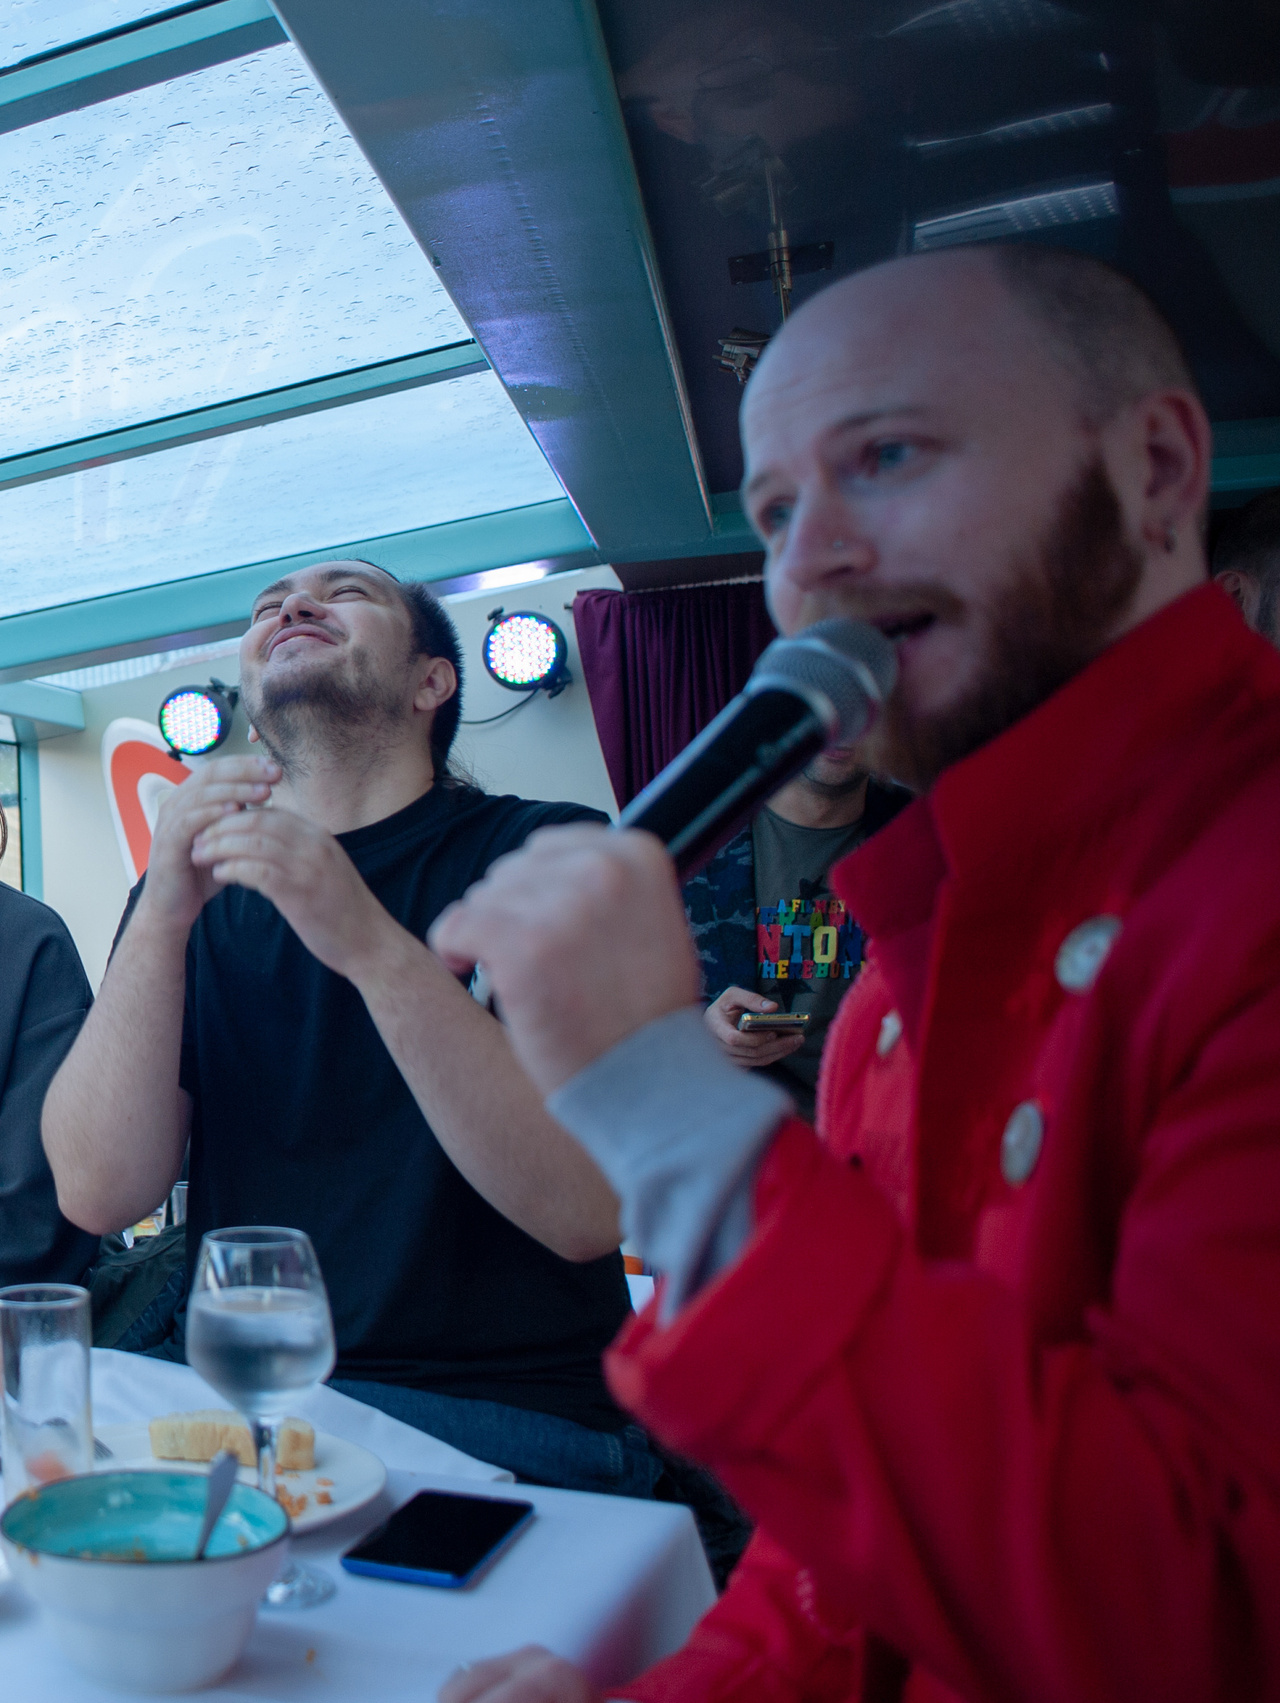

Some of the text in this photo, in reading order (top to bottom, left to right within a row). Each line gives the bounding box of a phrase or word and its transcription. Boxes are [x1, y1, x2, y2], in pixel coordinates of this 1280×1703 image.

[777, 899, 846, 914] A FILM BY
[758, 960, 815, 979] HERE
